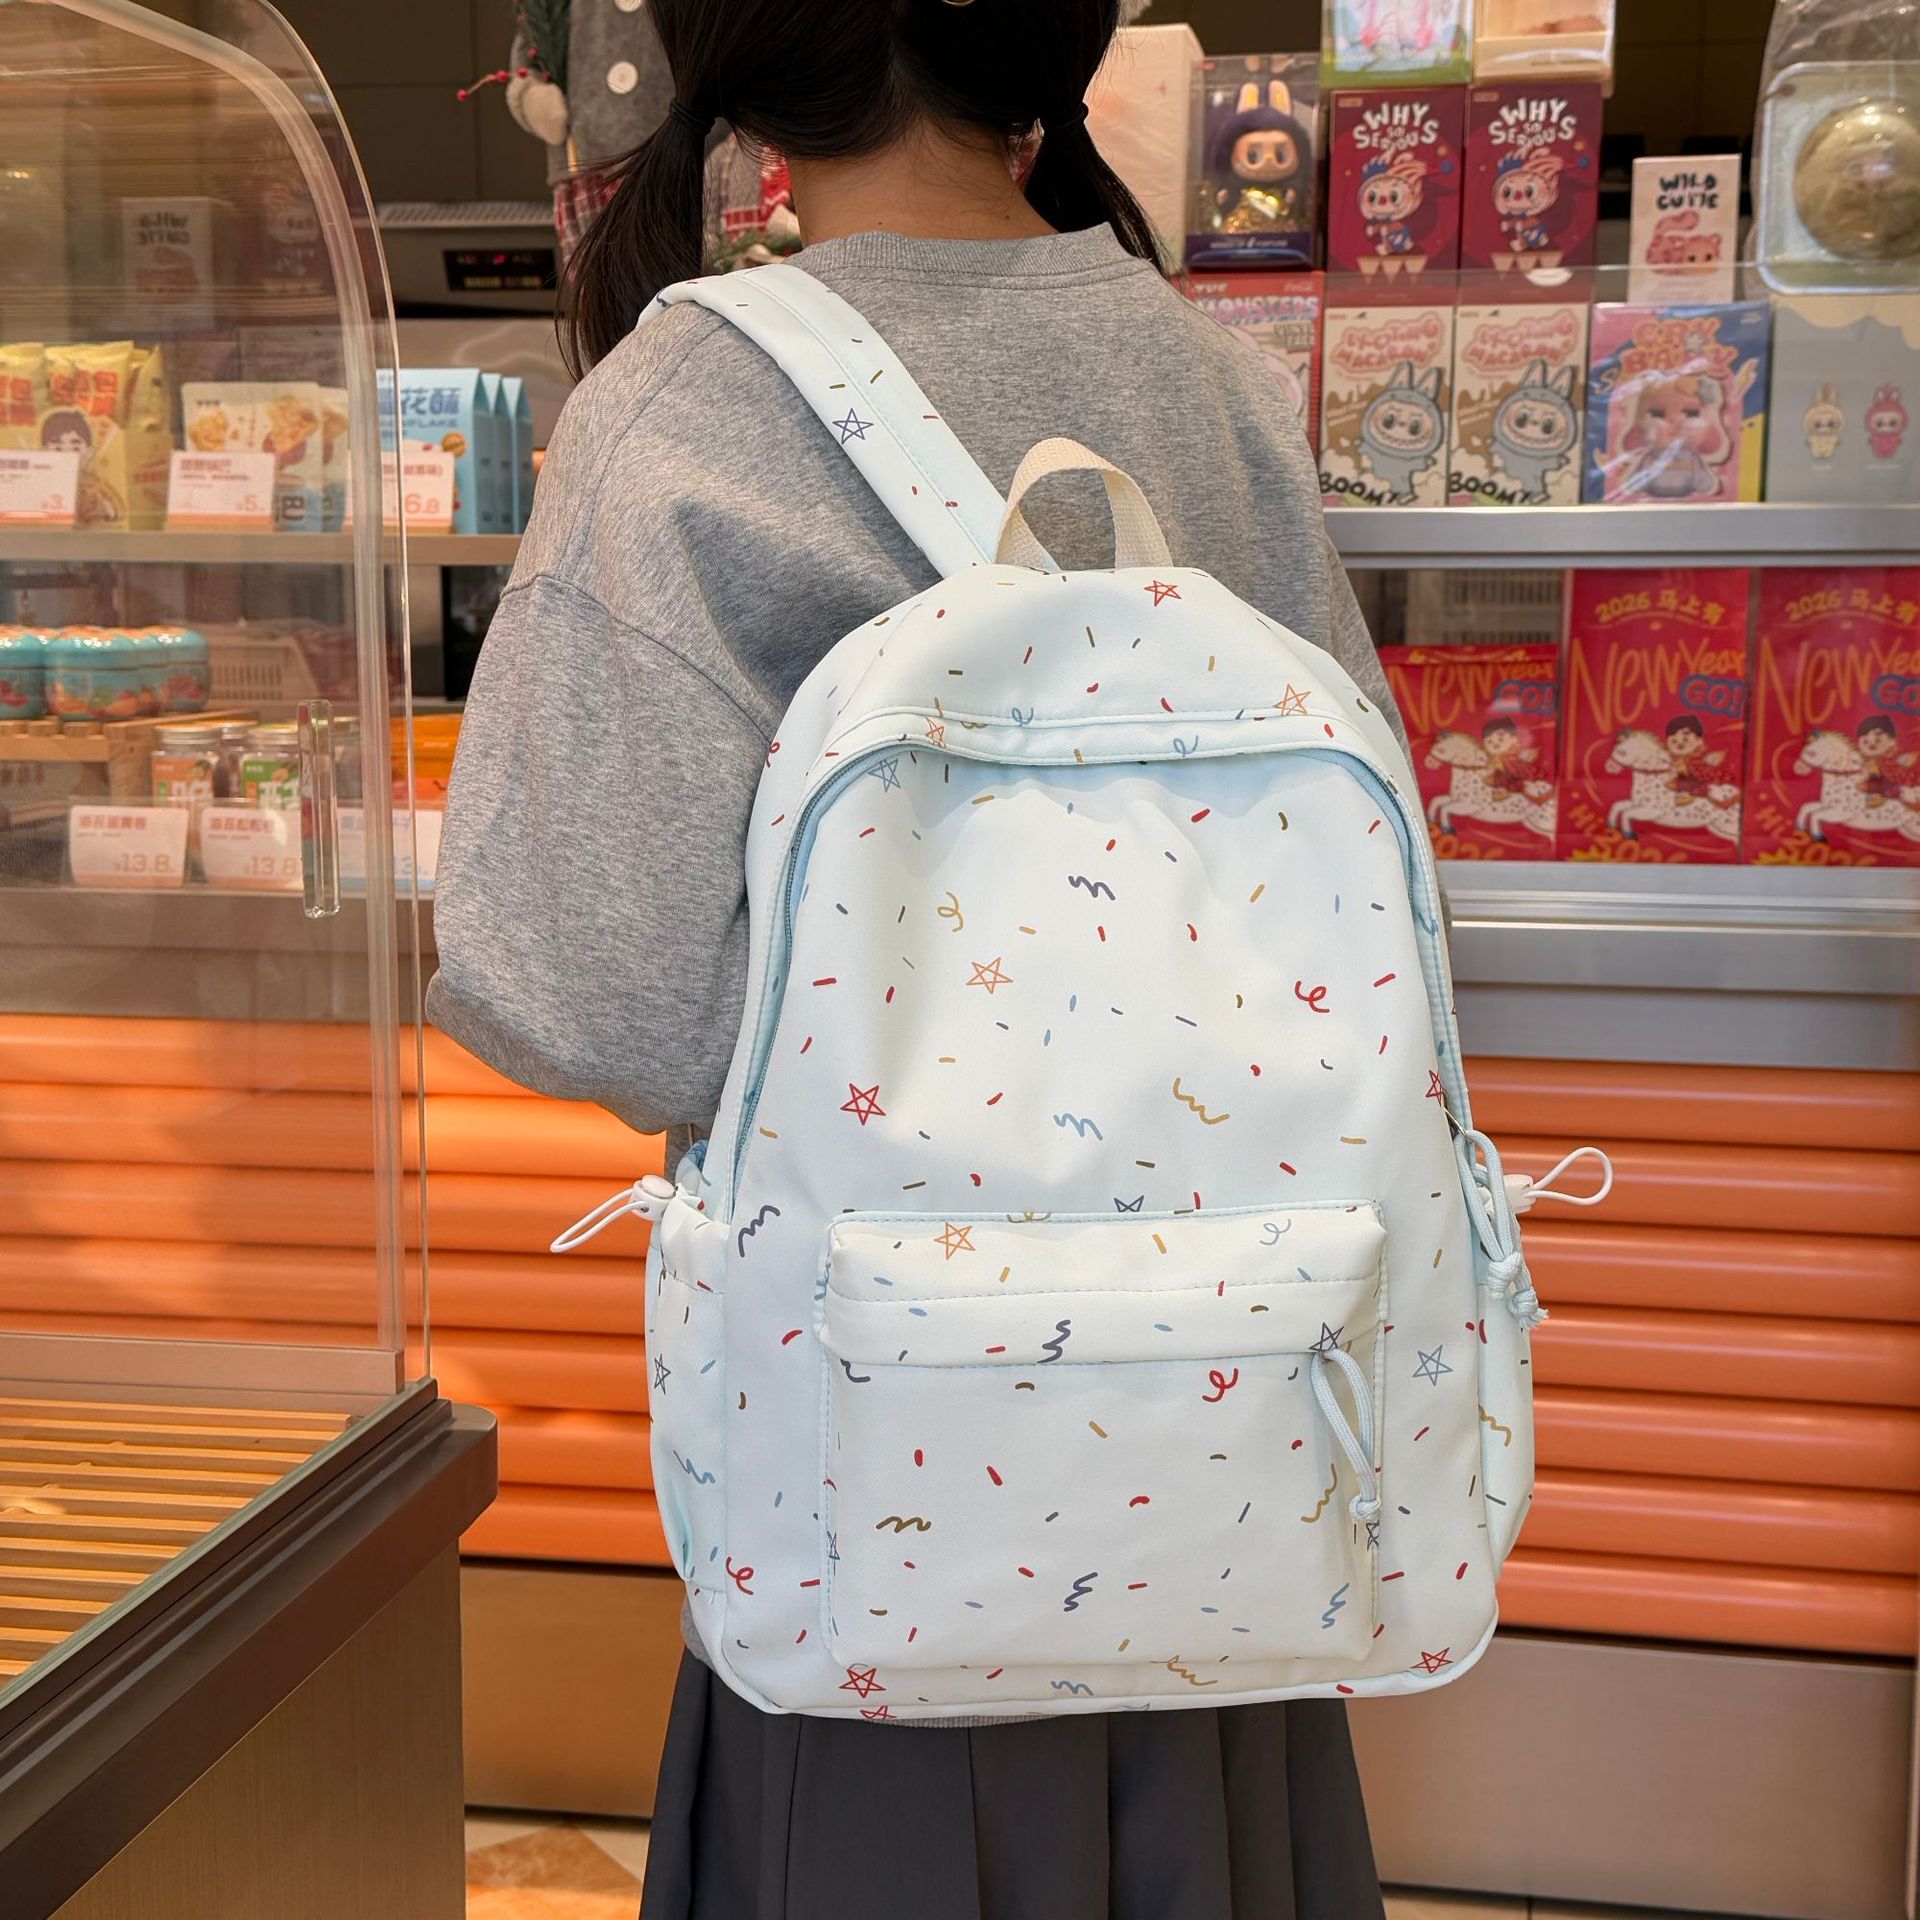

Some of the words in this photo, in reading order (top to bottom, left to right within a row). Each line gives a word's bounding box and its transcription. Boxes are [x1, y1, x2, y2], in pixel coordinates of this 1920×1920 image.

[1363, 101, 1430, 129] WHY
[1499, 97, 1569, 126] WHY
[1352, 119, 1439, 151] SERIOUS
[1488, 115, 1577, 148] SERIOUS
[1659, 174, 1717, 191] WILD
[1656, 194, 1719, 210] CUTIE
[1196, 295, 1320, 326] MONSTERS
[1596, 591, 1651, 623] 2026
[1785, 590, 1841, 622] 2026
[1387, 663, 1494, 735] New
[1500, 684, 1555, 712] GO!
[1566, 637, 1682, 782] New
[1686, 679, 1744, 715] GO!
[1753, 637, 1874, 783] New
